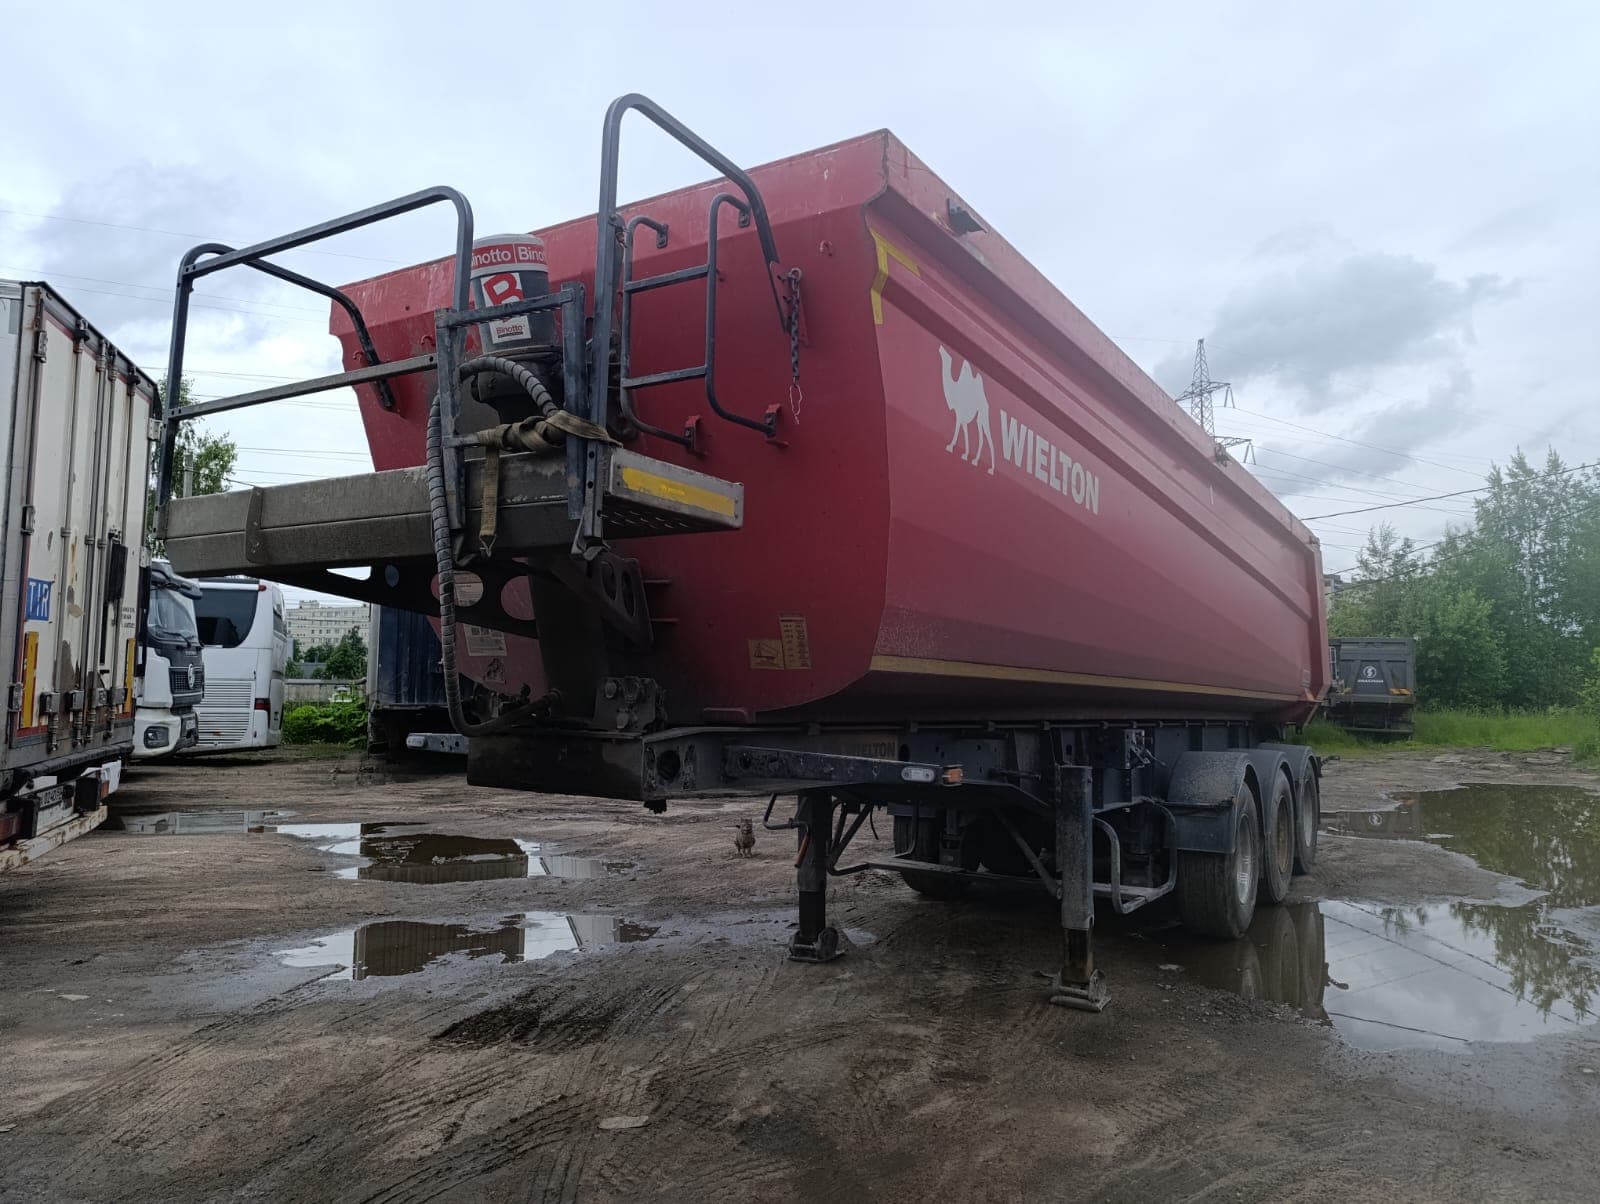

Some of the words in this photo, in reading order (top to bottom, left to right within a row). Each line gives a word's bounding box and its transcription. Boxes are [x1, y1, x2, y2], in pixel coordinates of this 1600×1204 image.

[471, 249, 511, 266] inotto
[1000, 408, 1099, 515] WIELTON
[28, 581, 49, 617] TIR
